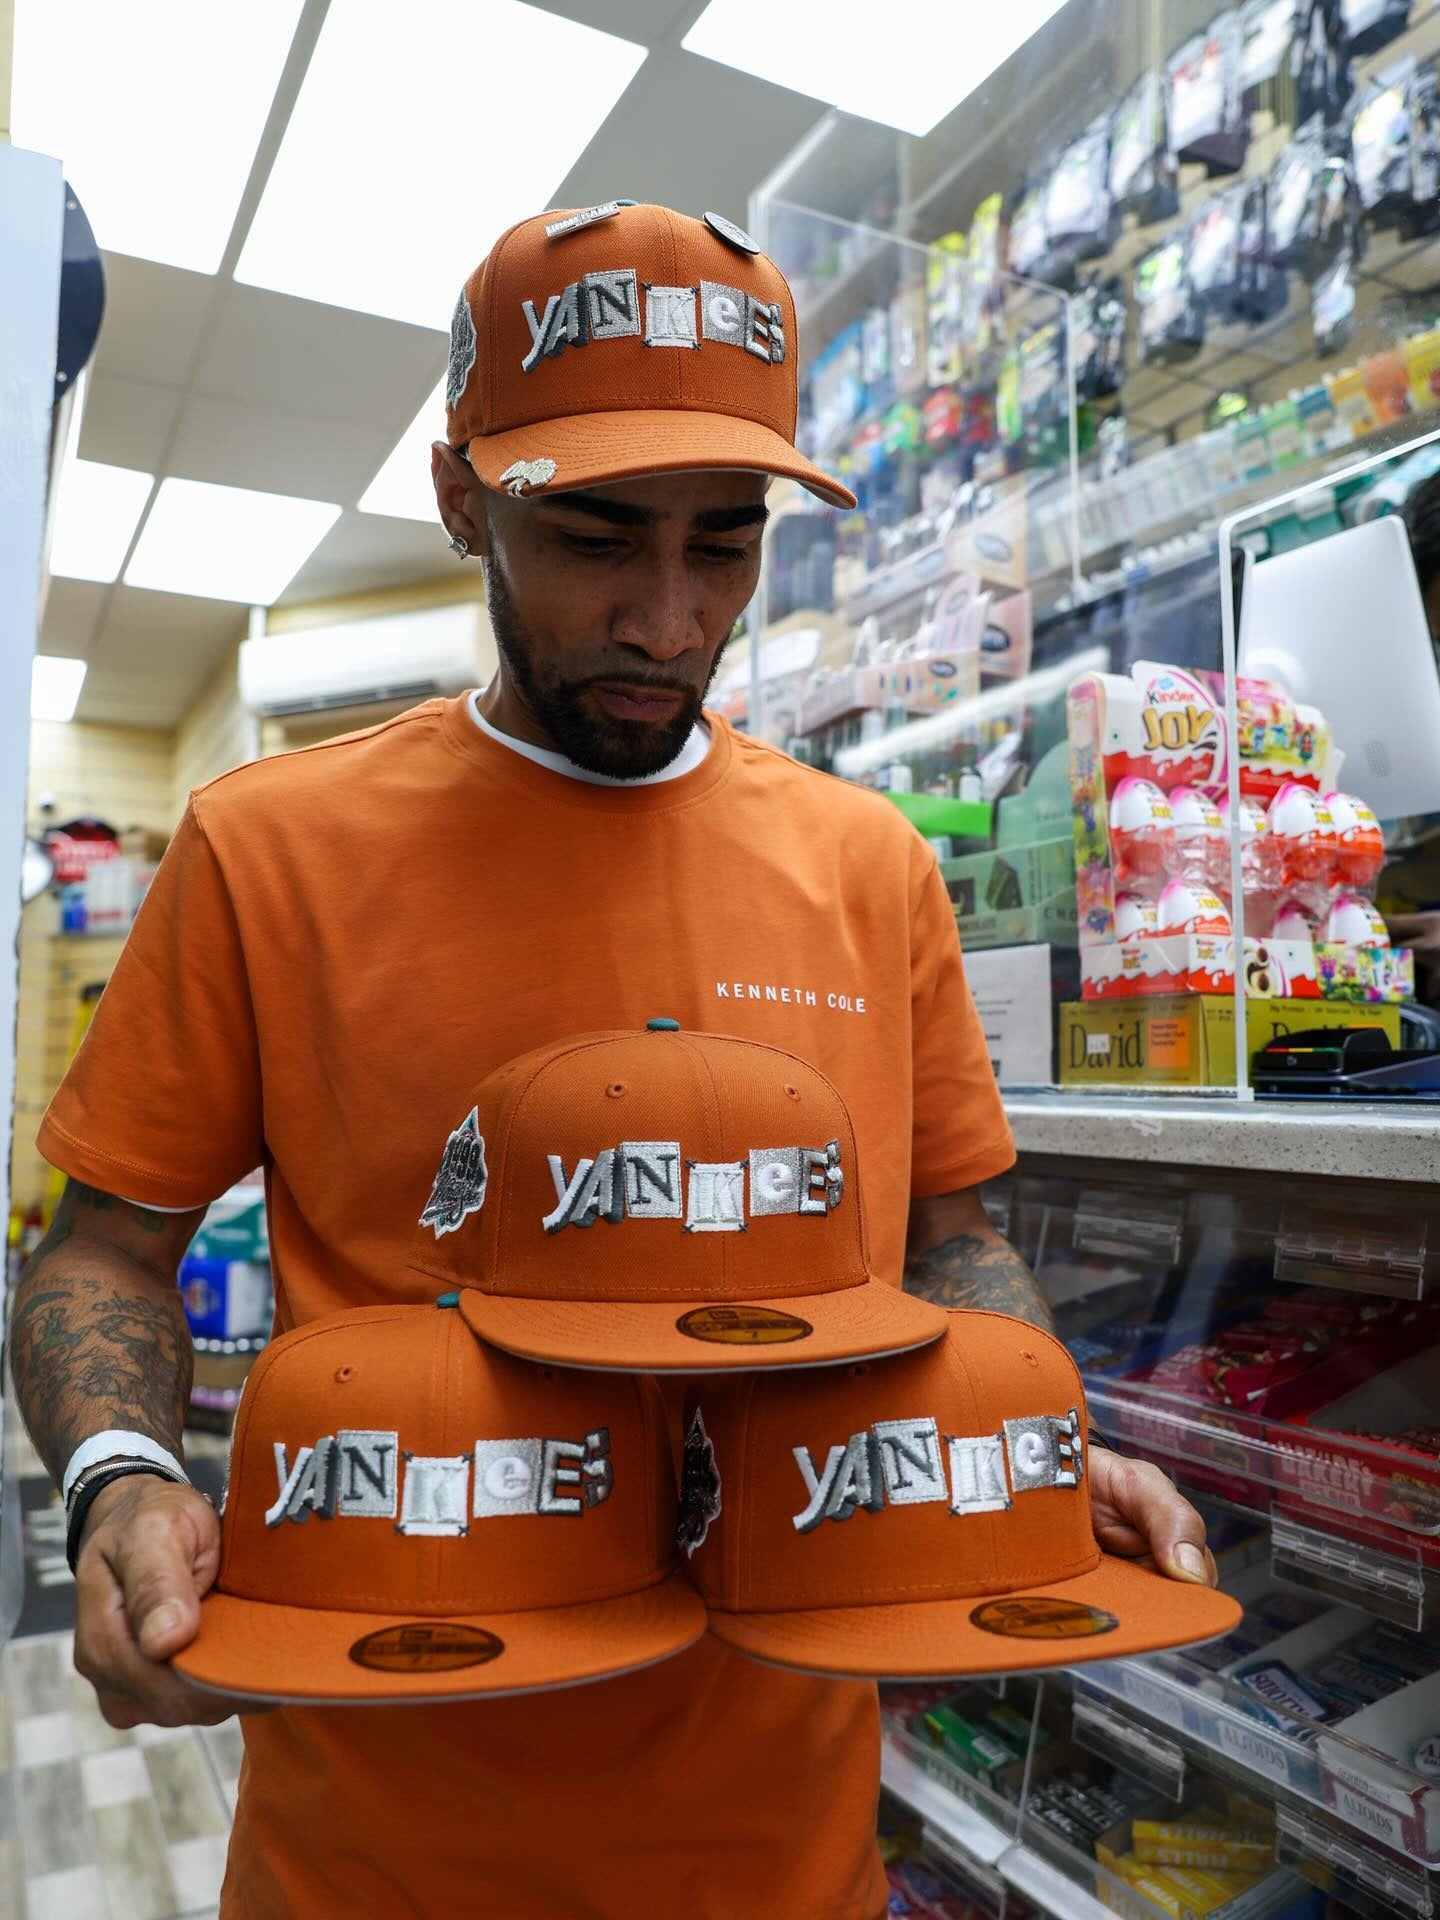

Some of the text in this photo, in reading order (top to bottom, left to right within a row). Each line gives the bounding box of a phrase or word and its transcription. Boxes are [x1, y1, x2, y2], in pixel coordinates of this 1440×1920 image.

[1142, 705, 1215, 751] JOY
[716, 982, 867, 1013] KENNETH COLE
[1343, 1793, 1394, 1833] ALTOIDS
